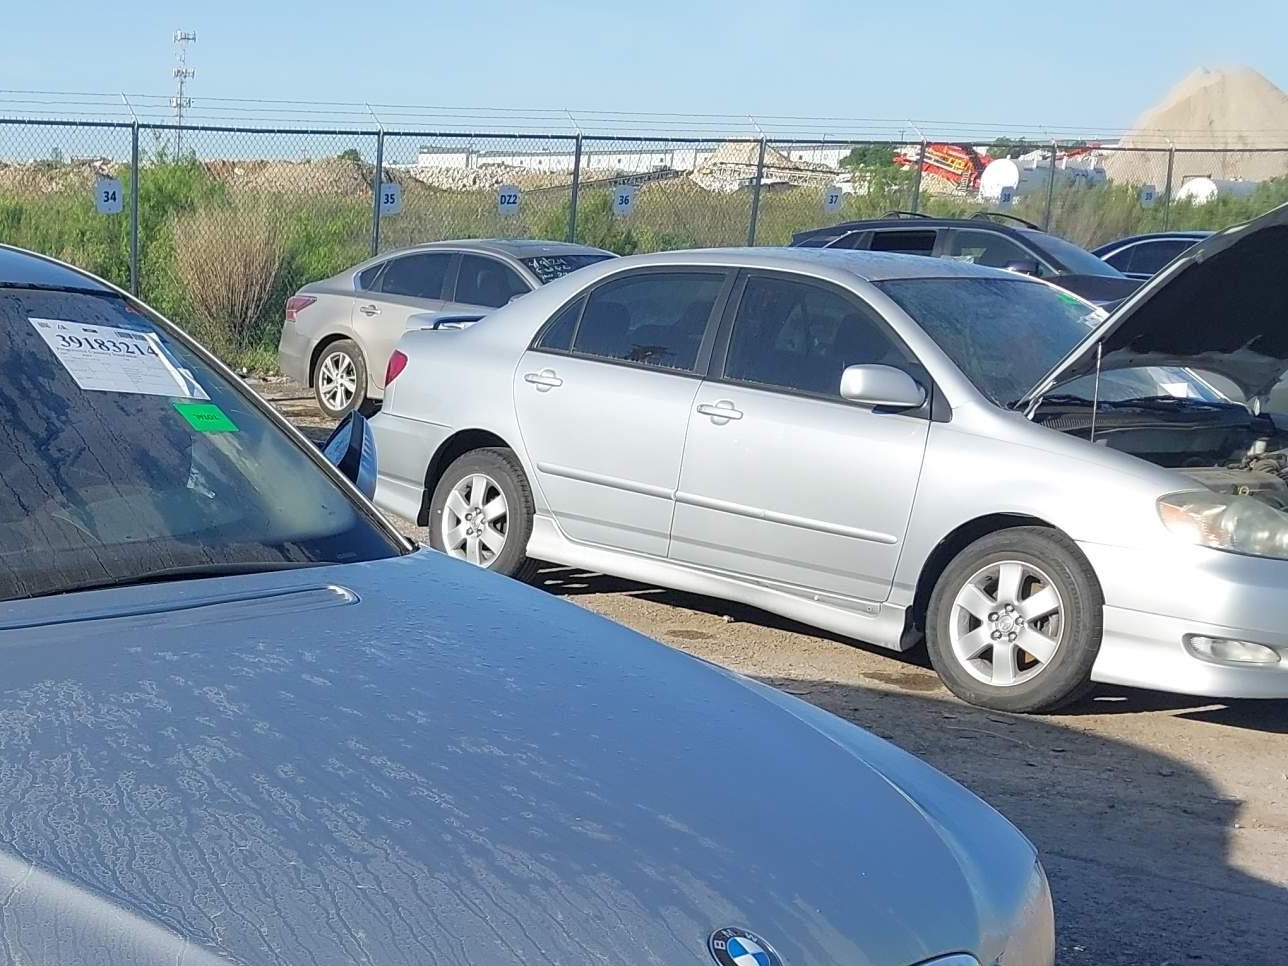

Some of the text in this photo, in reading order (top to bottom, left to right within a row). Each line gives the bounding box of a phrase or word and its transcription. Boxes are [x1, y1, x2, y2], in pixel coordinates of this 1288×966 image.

[103, 190, 117, 203] 34
[383, 192, 396, 205] 35
[499, 194, 518, 206] DZ2
[618, 194, 630, 206] 36
[828, 194, 839, 205] 37
[56, 334, 159, 357] 39183214
[714, 928, 759, 950] BMW
